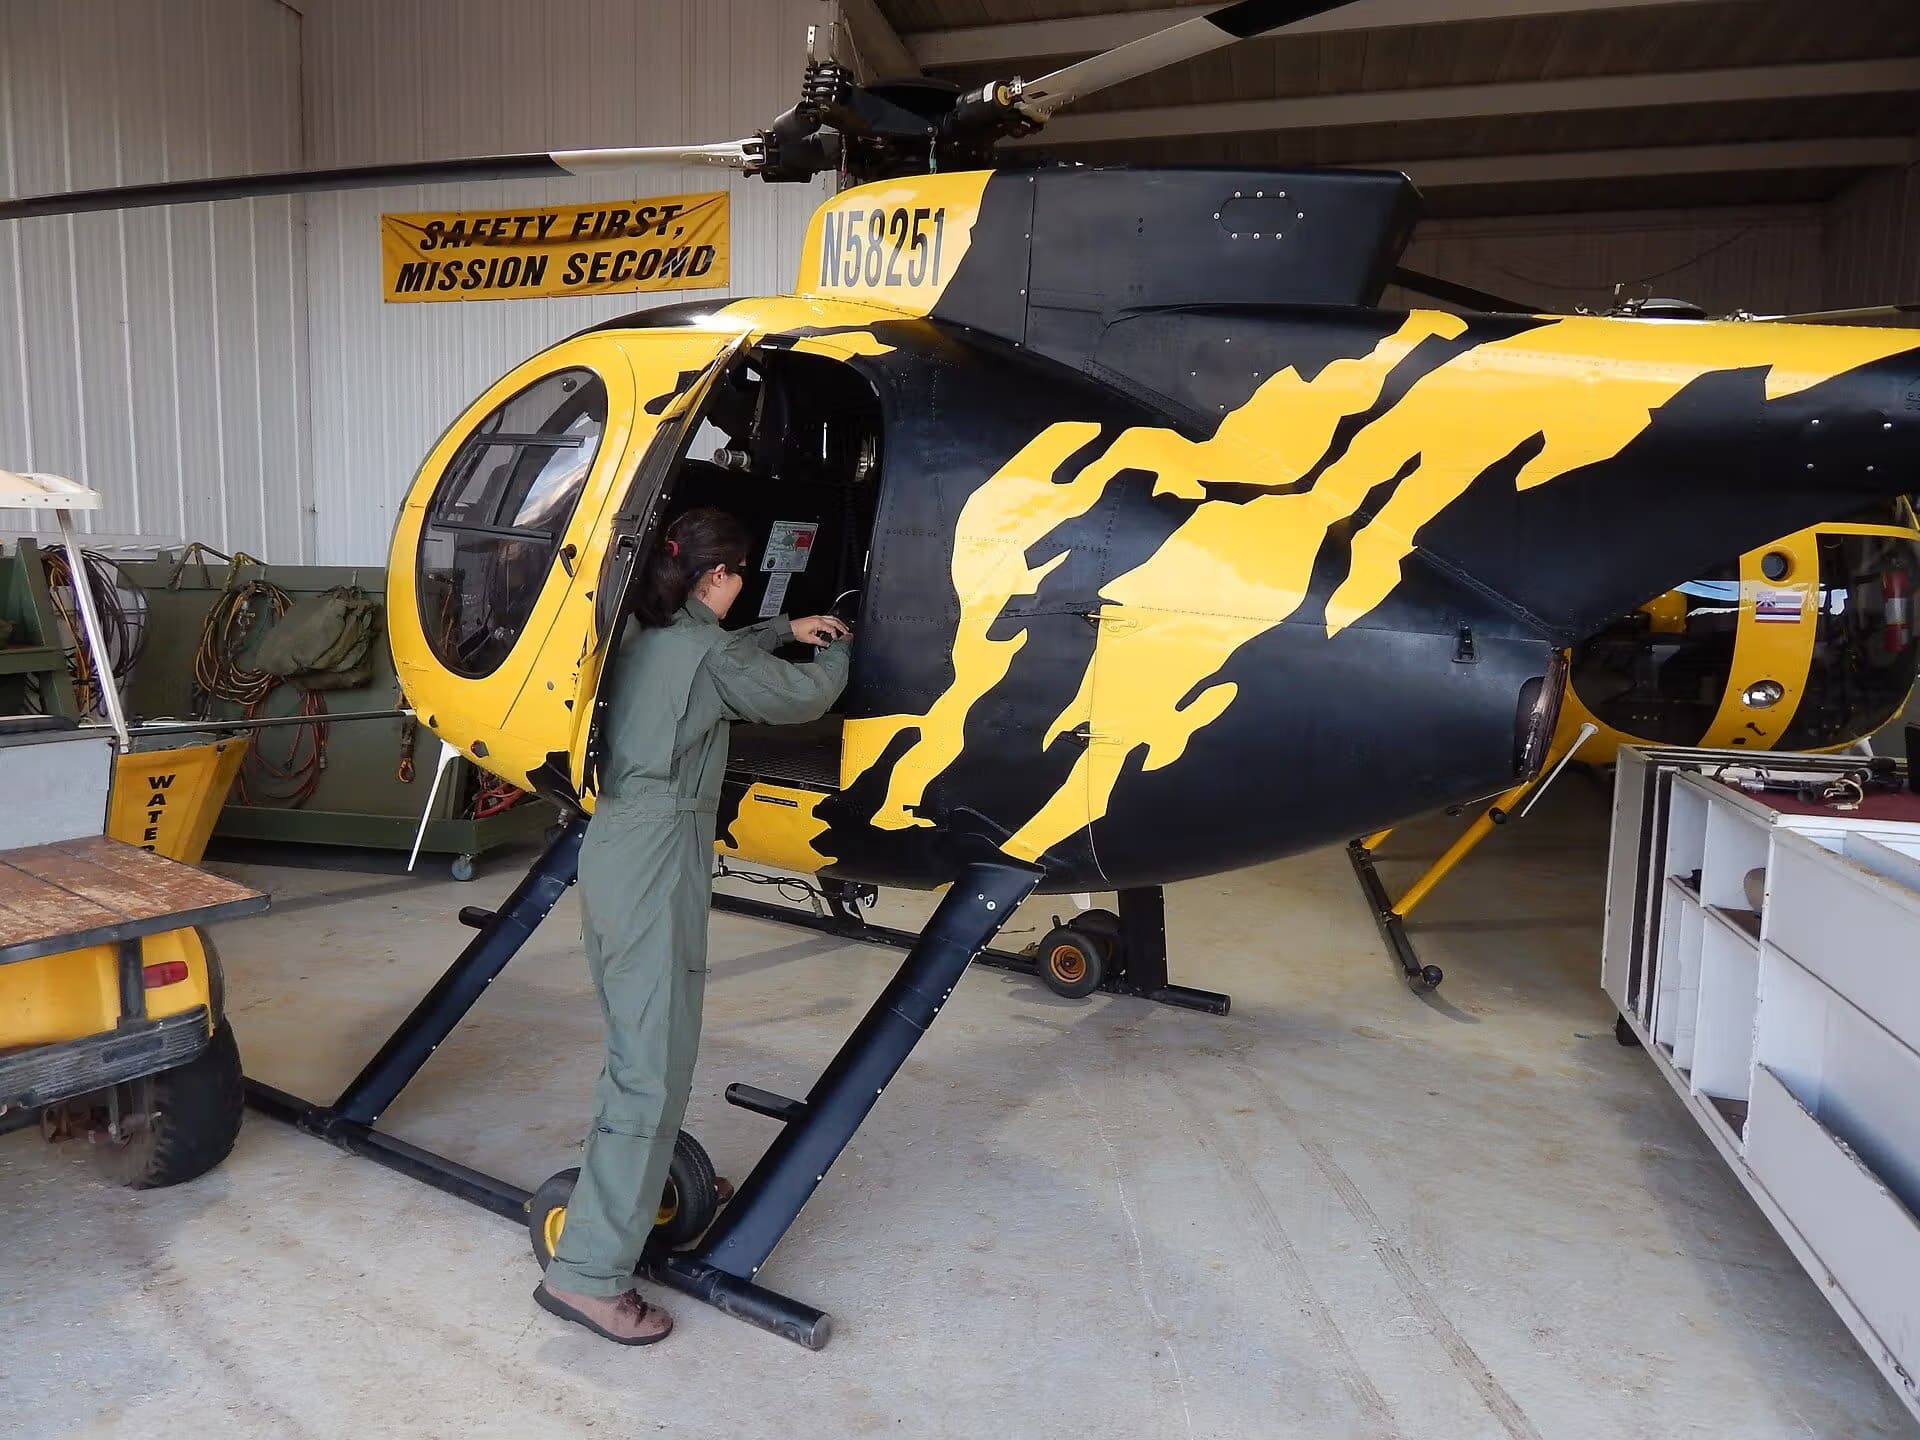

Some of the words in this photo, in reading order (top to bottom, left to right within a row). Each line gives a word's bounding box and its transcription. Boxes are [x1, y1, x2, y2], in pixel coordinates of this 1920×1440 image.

[420, 215, 557, 250] SAFETY
[571, 204, 683, 241] FIRST,
[821, 207, 945, 288] N58251
[395, 255, 548, 292] MISSION
[562, 245, 715, 284] SECOND
